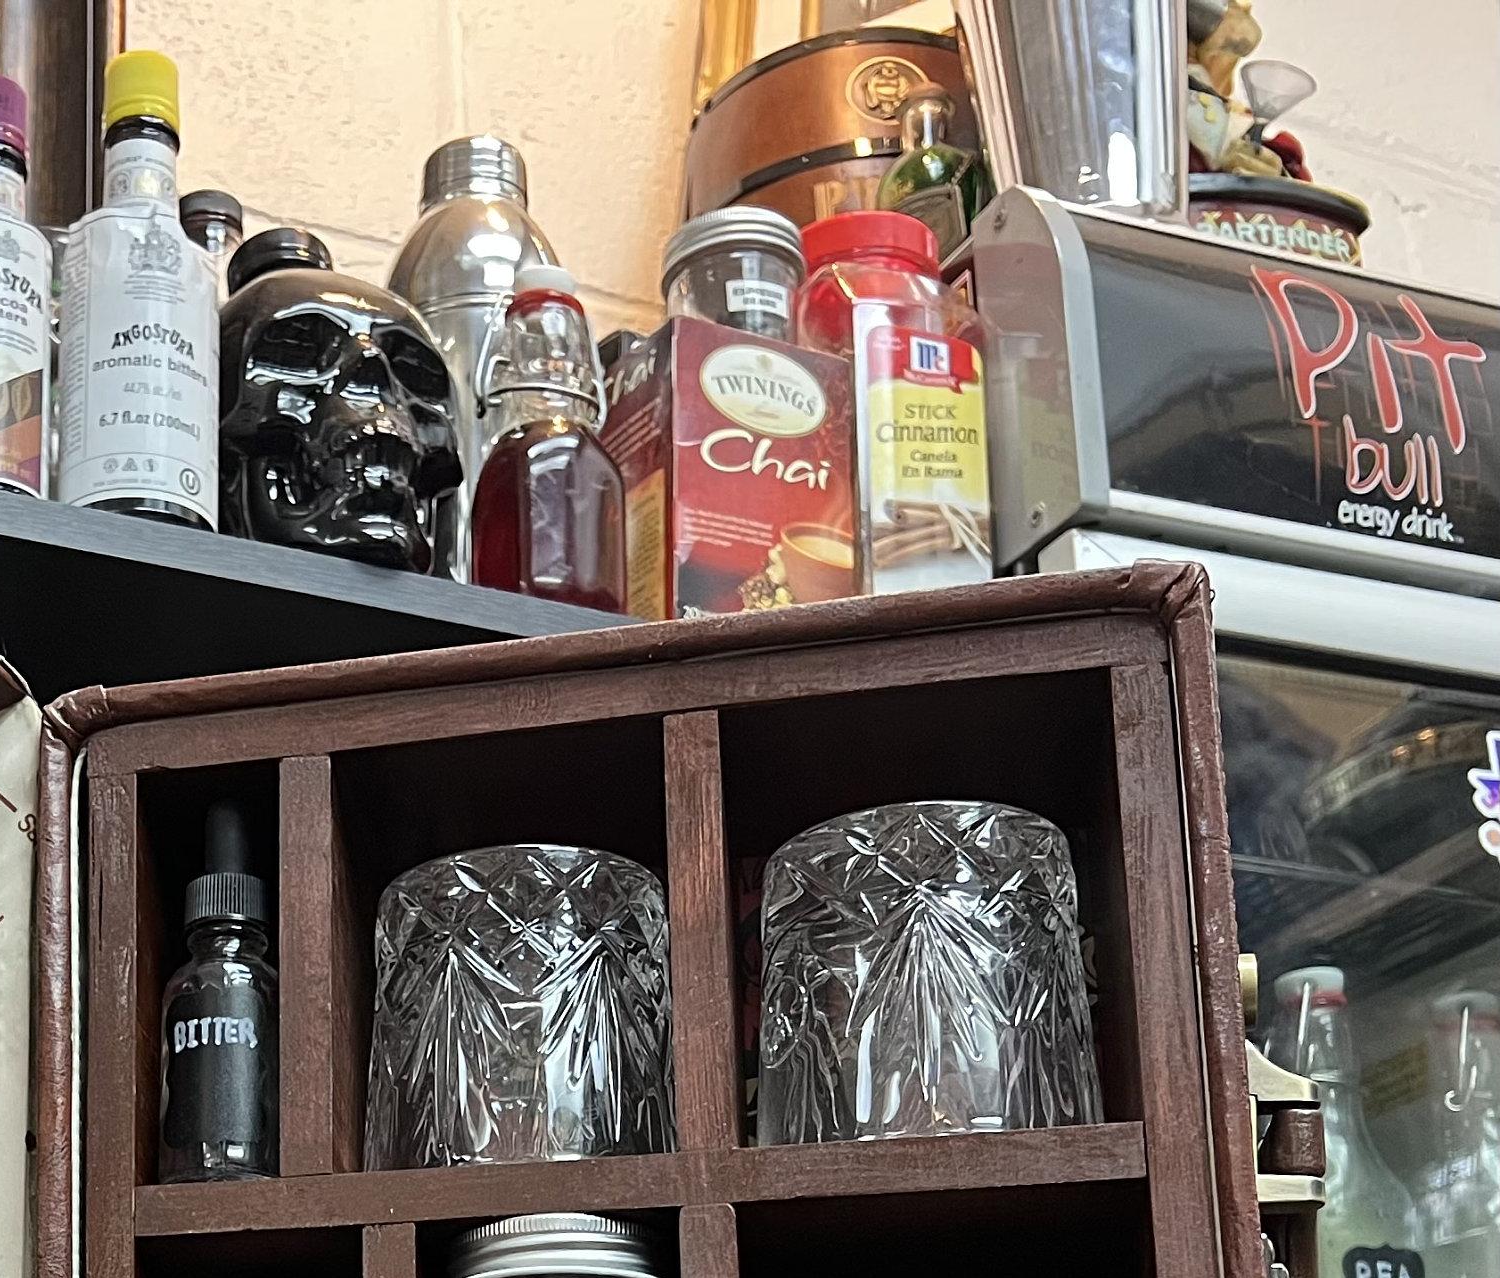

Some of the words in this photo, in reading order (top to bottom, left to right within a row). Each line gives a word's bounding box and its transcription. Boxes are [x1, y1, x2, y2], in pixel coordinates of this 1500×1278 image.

[1195, 221, 1351, 263] BARTENDER
[111, 323, 195, 361] ANGOSTURA
[92, 354, 162, 373] aromatic
[167, 357, 208, 388] bitters
[710, 374, 817, 419] TWININGS
[904, 403, 958, 420] STICK
[875, 420, 980, 446] Cinnamon
[700, 428, 833, 491] Chai
[910, 449, 958, 463] Canela
[923, 465, 964, 479] Rama
[1342, 414, 1444, 507] bull
[1337, 500, 1400, 538] energy
[1401, 506, 1455, 542] drink
[174, 1016, 258, 1053] BITTER
